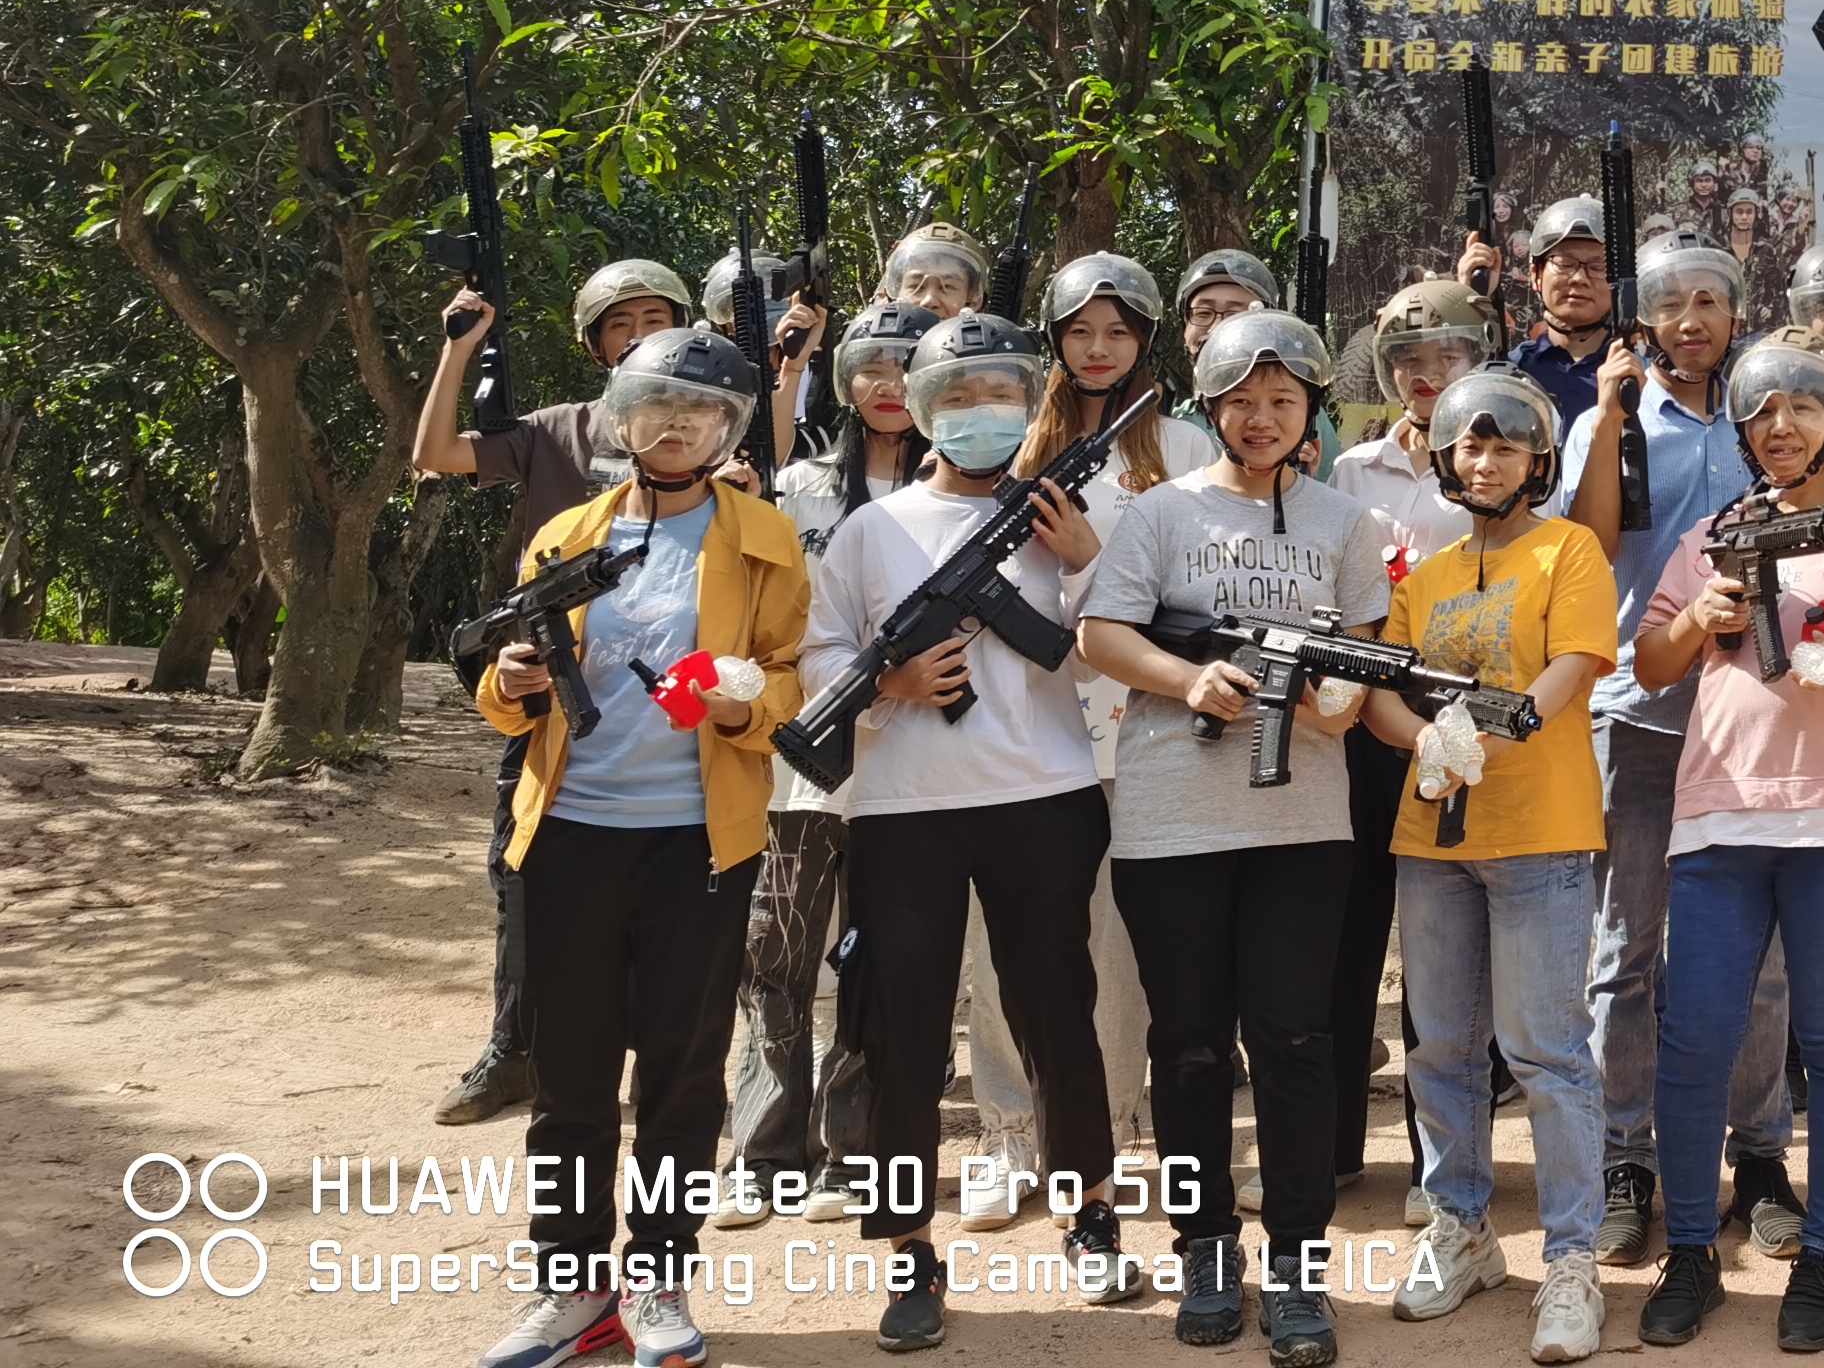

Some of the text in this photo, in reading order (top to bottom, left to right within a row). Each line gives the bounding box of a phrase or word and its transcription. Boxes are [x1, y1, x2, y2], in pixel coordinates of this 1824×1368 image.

[1361, 37, 1785, 77] 开启全新亲子团建旅游
[1186, 537, 1323, 585] HONOLULU
[1213, 575, 1303, 613] ALOHA
